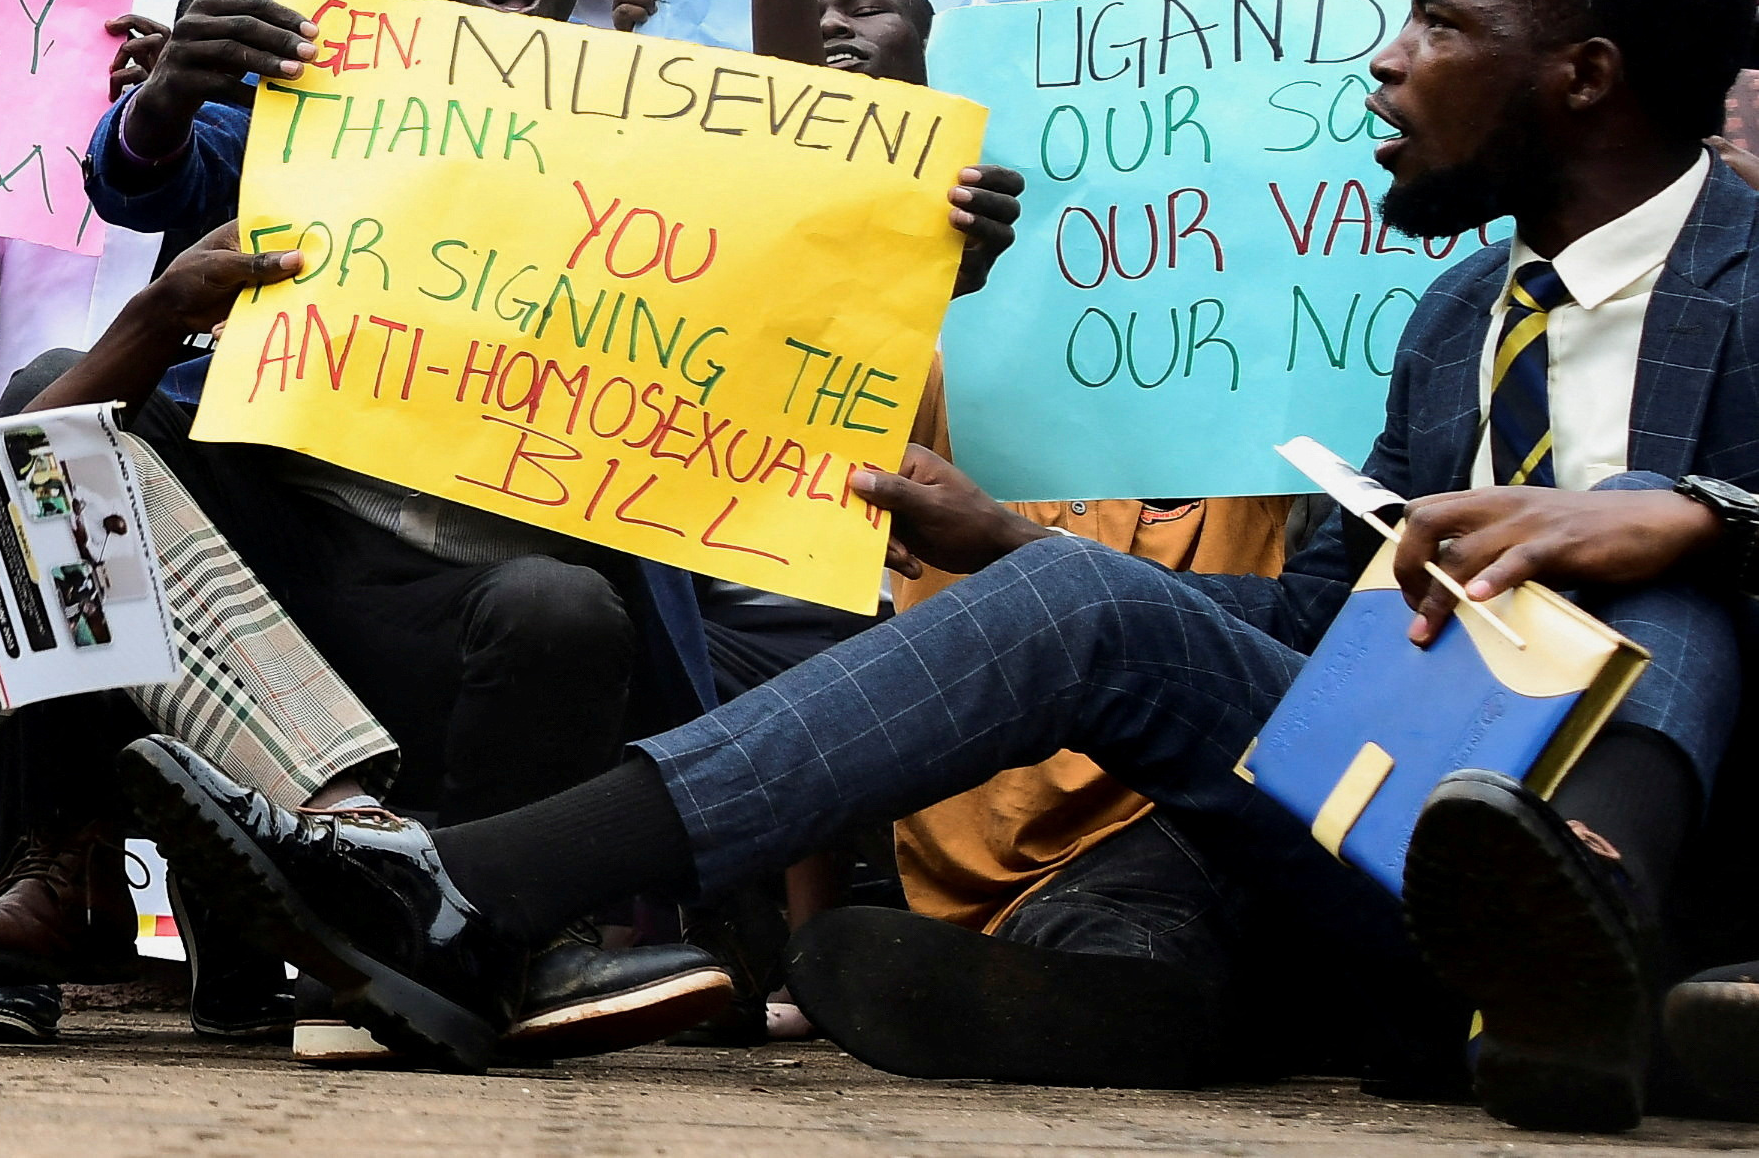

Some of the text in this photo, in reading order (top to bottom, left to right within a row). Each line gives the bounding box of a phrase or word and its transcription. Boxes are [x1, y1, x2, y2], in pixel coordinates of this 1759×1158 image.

[266, 81, 545, 174] THANK
[447, 15, 943, 179] MUSEVENI
[1041, 85, 1212, 182] OUR
[567, 179, 718, 283] YOU
[1056, 187, 1224, 290] OUR
[418, 240, 725, 406] SIGNING
[785, 338, 900, 434] THE
[1066, 298, 1240, 392] OUR
[455, 414, 790, 567] BILL
